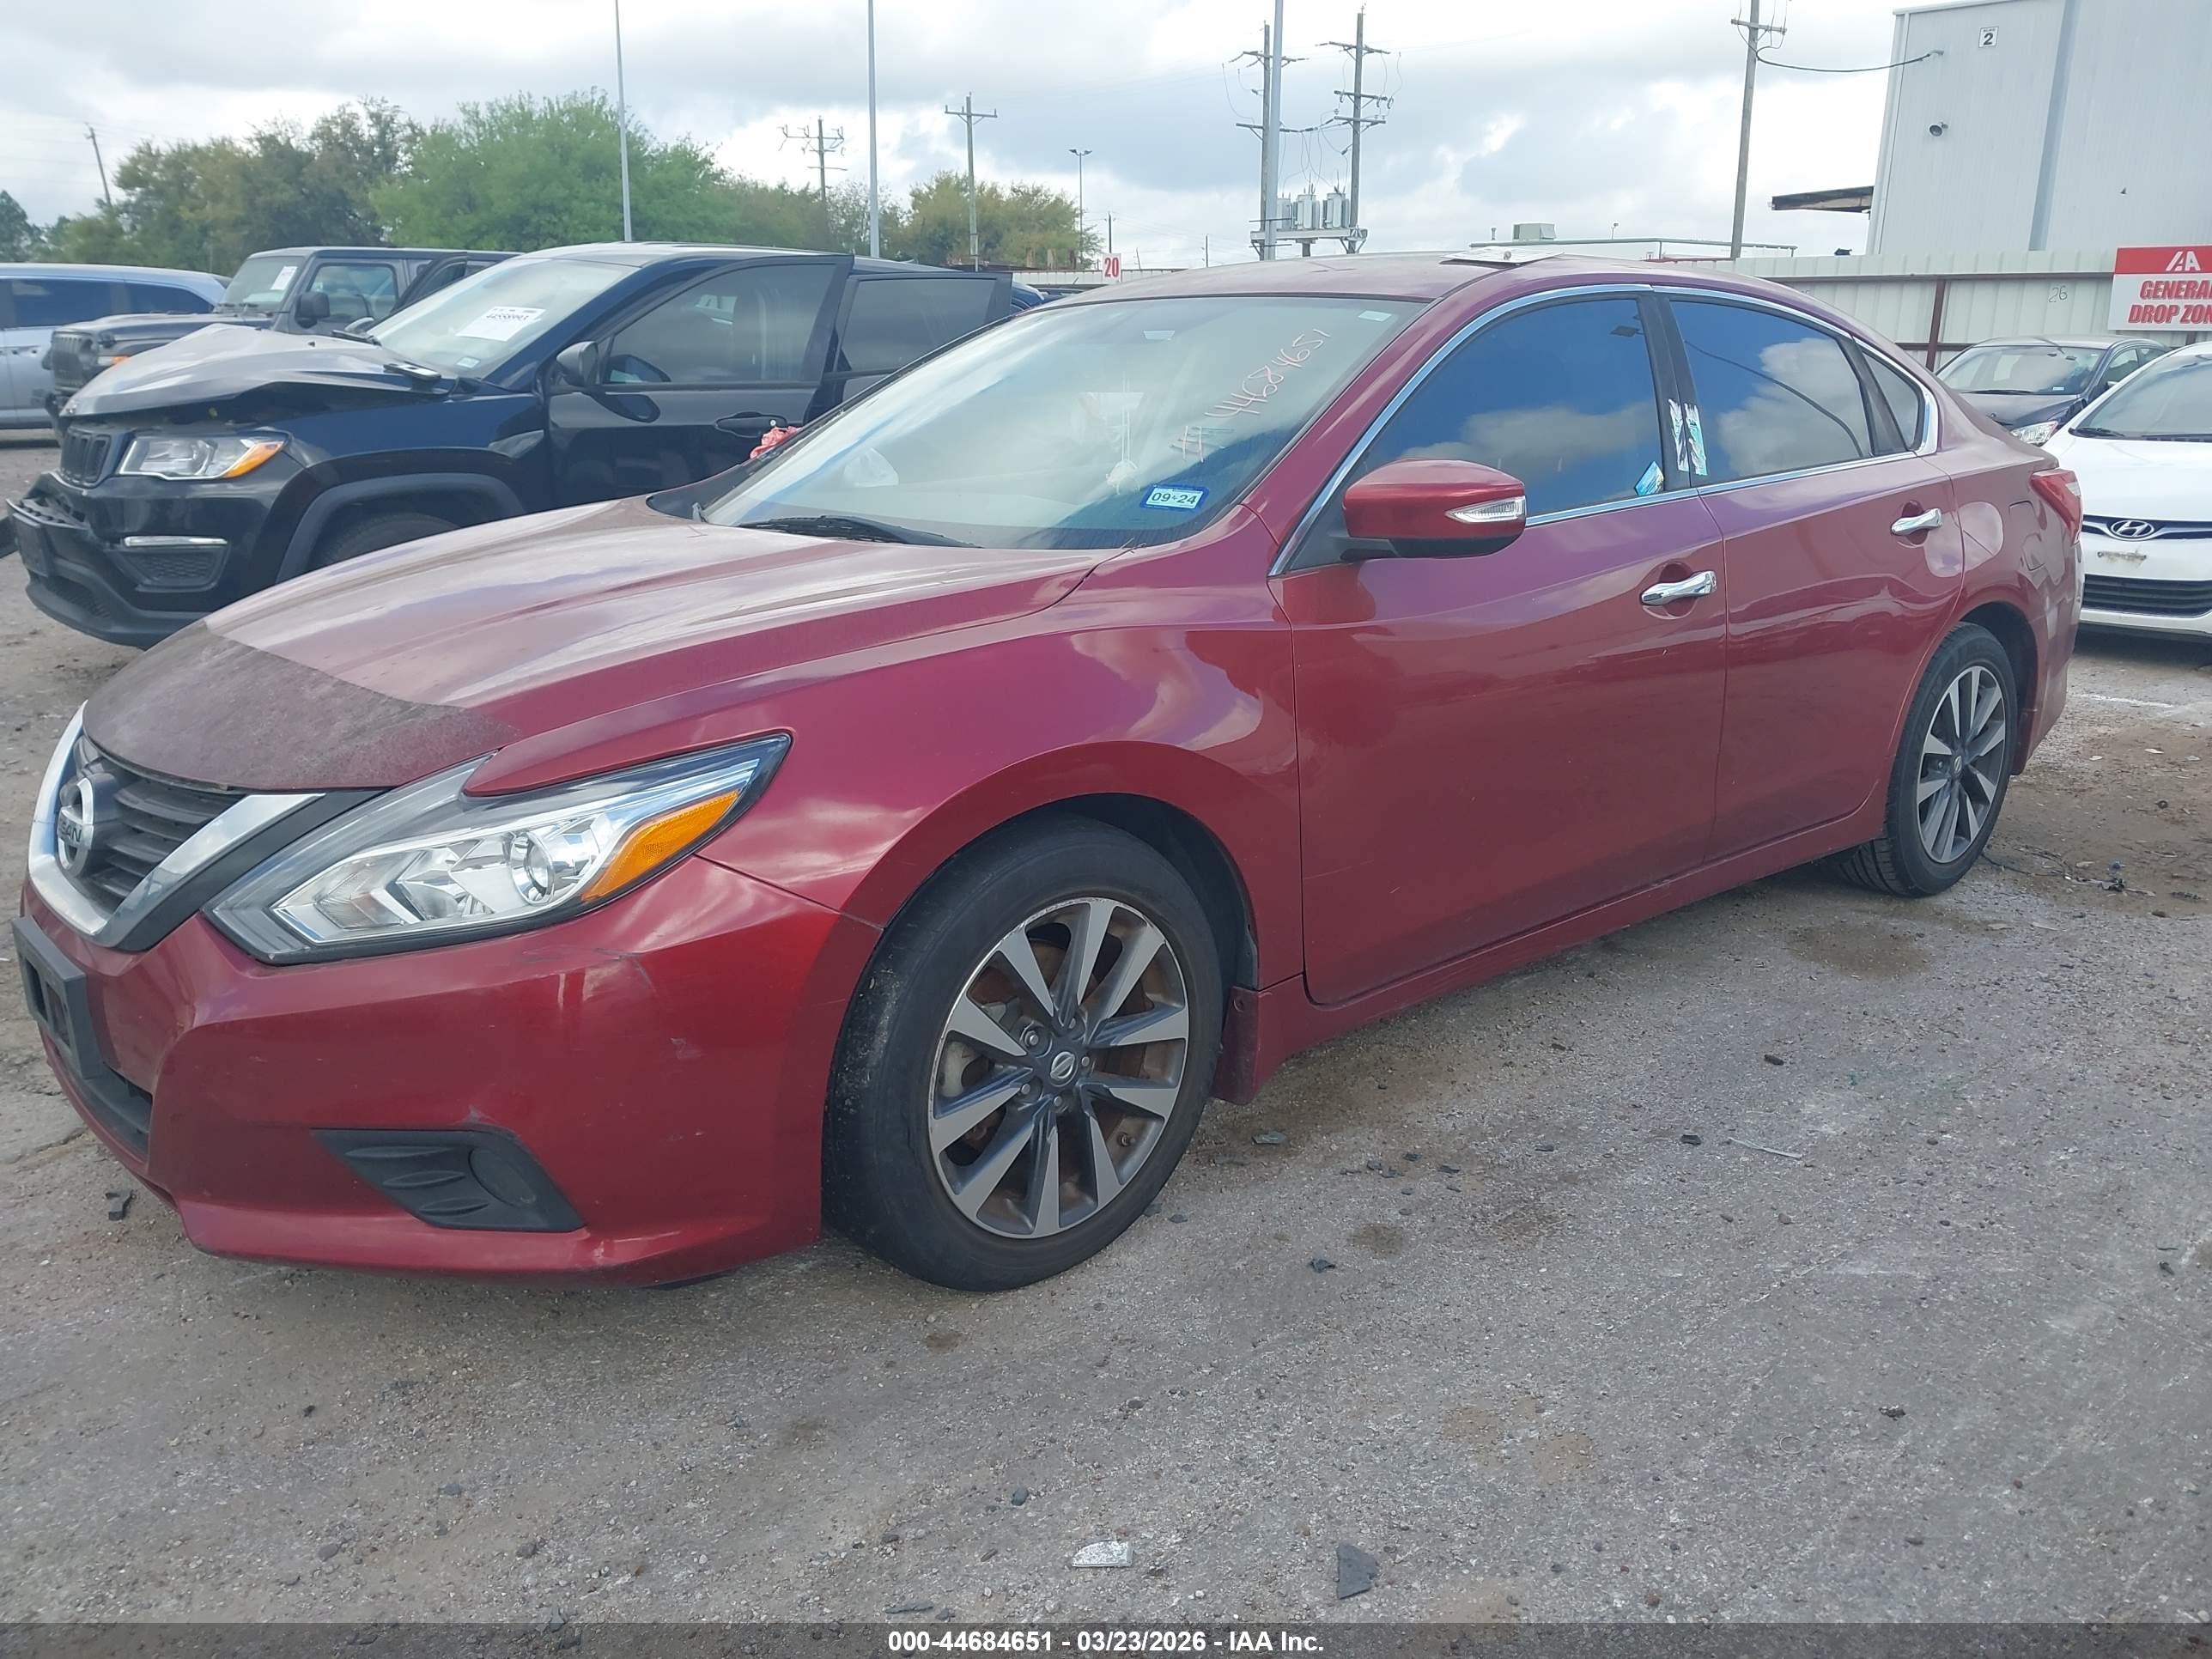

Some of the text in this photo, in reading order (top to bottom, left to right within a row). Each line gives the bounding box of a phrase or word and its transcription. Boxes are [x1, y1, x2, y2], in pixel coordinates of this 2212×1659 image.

[1984, 32, 1994, 46] 2
[1104, 257, 1120, 278] 20
[2048, 285, 2068, 303] 26
[2139, 279, 2212, 300] GENERA
[2128, 304, 2181, 324] DROP
